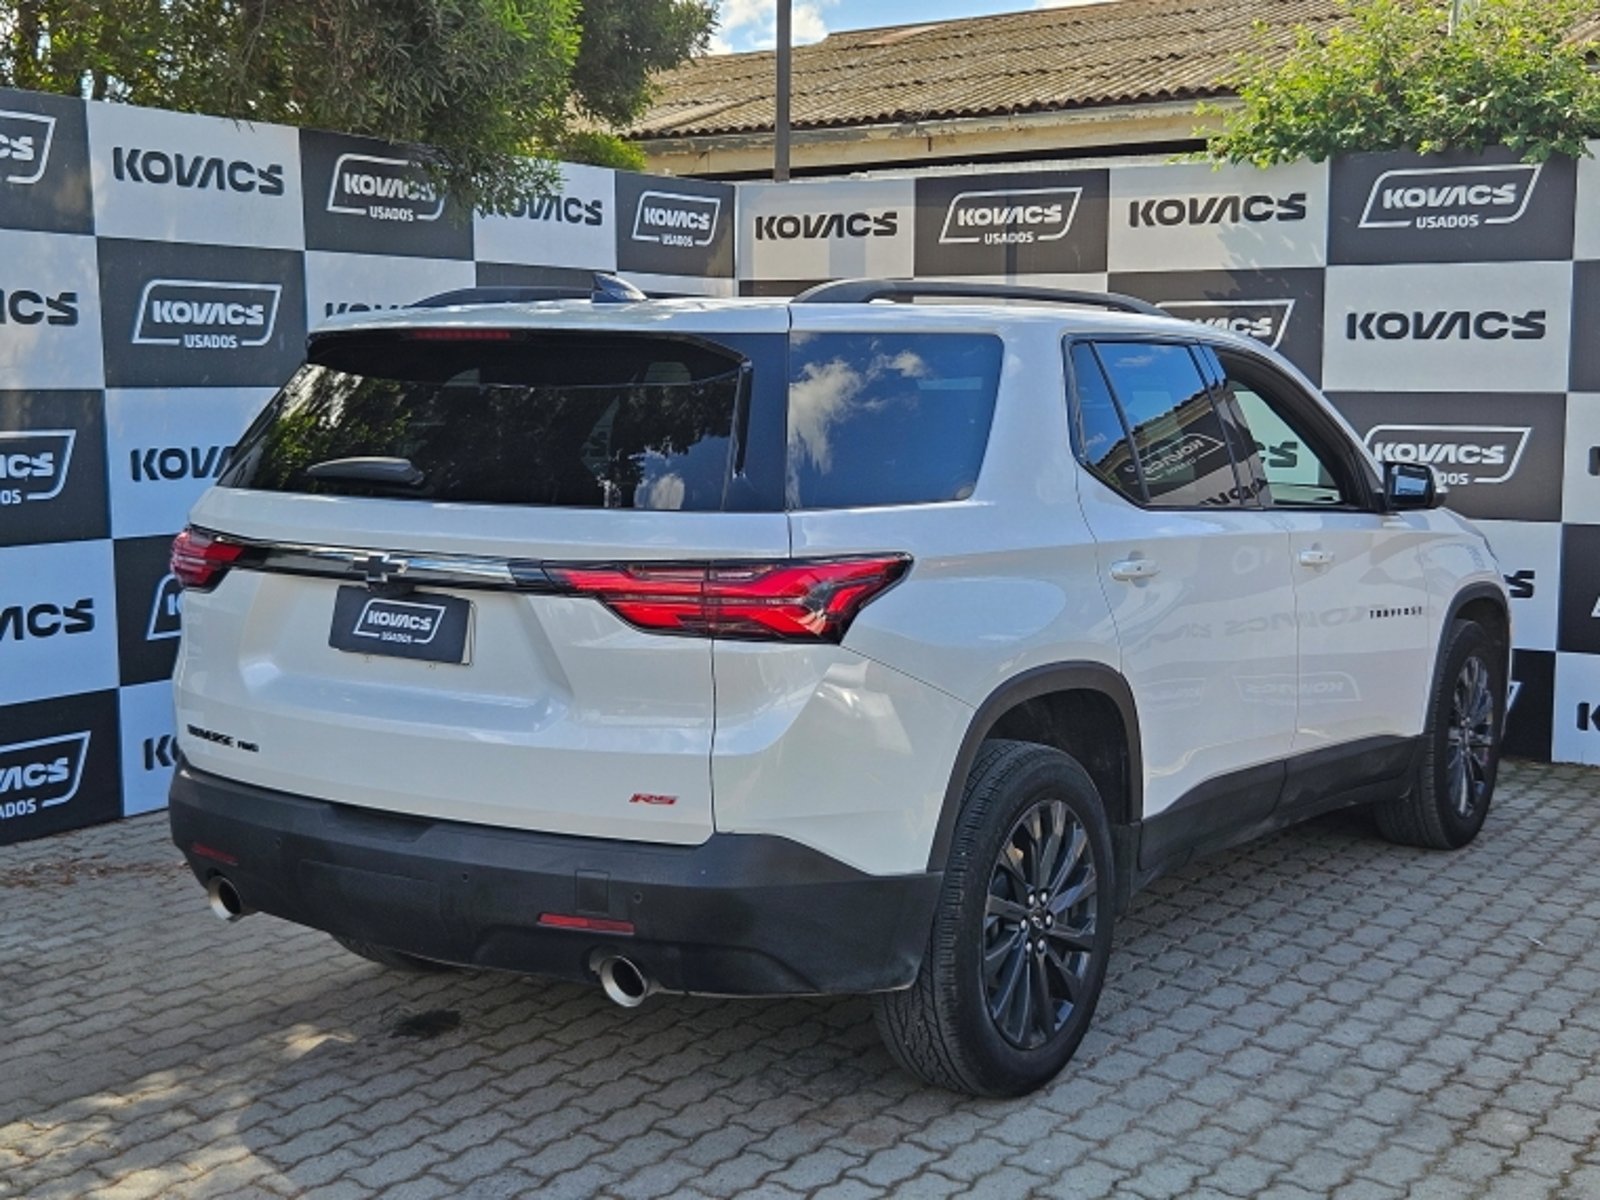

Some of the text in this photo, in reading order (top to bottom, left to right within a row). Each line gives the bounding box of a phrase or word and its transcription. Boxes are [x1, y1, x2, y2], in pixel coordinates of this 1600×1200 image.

[112, 146, 284, 196] KOVACS
[1382, 183, 1517, 209] KOVACS
[369, 205, 414, 222] USADOS
[644, 206, 710, 230] KOVACS
[957, 204, 1062, 226] KOVACS
[1129, 193, 1307, 227] KOVACS
[1416, 214, 1479, 229] USADOS
[755, 212, 897, 240] KOVACS
[984, 231, 1034, 245] USADOS
[153, 300, 264, 326] KOVACS
[1346, 310, 1546, 340] KOVACS
[184, 334, 238, 349] USADOS
[1374, 442, 1505, 464] KOVACS
[367, 610, 432, 631] KOVACS
